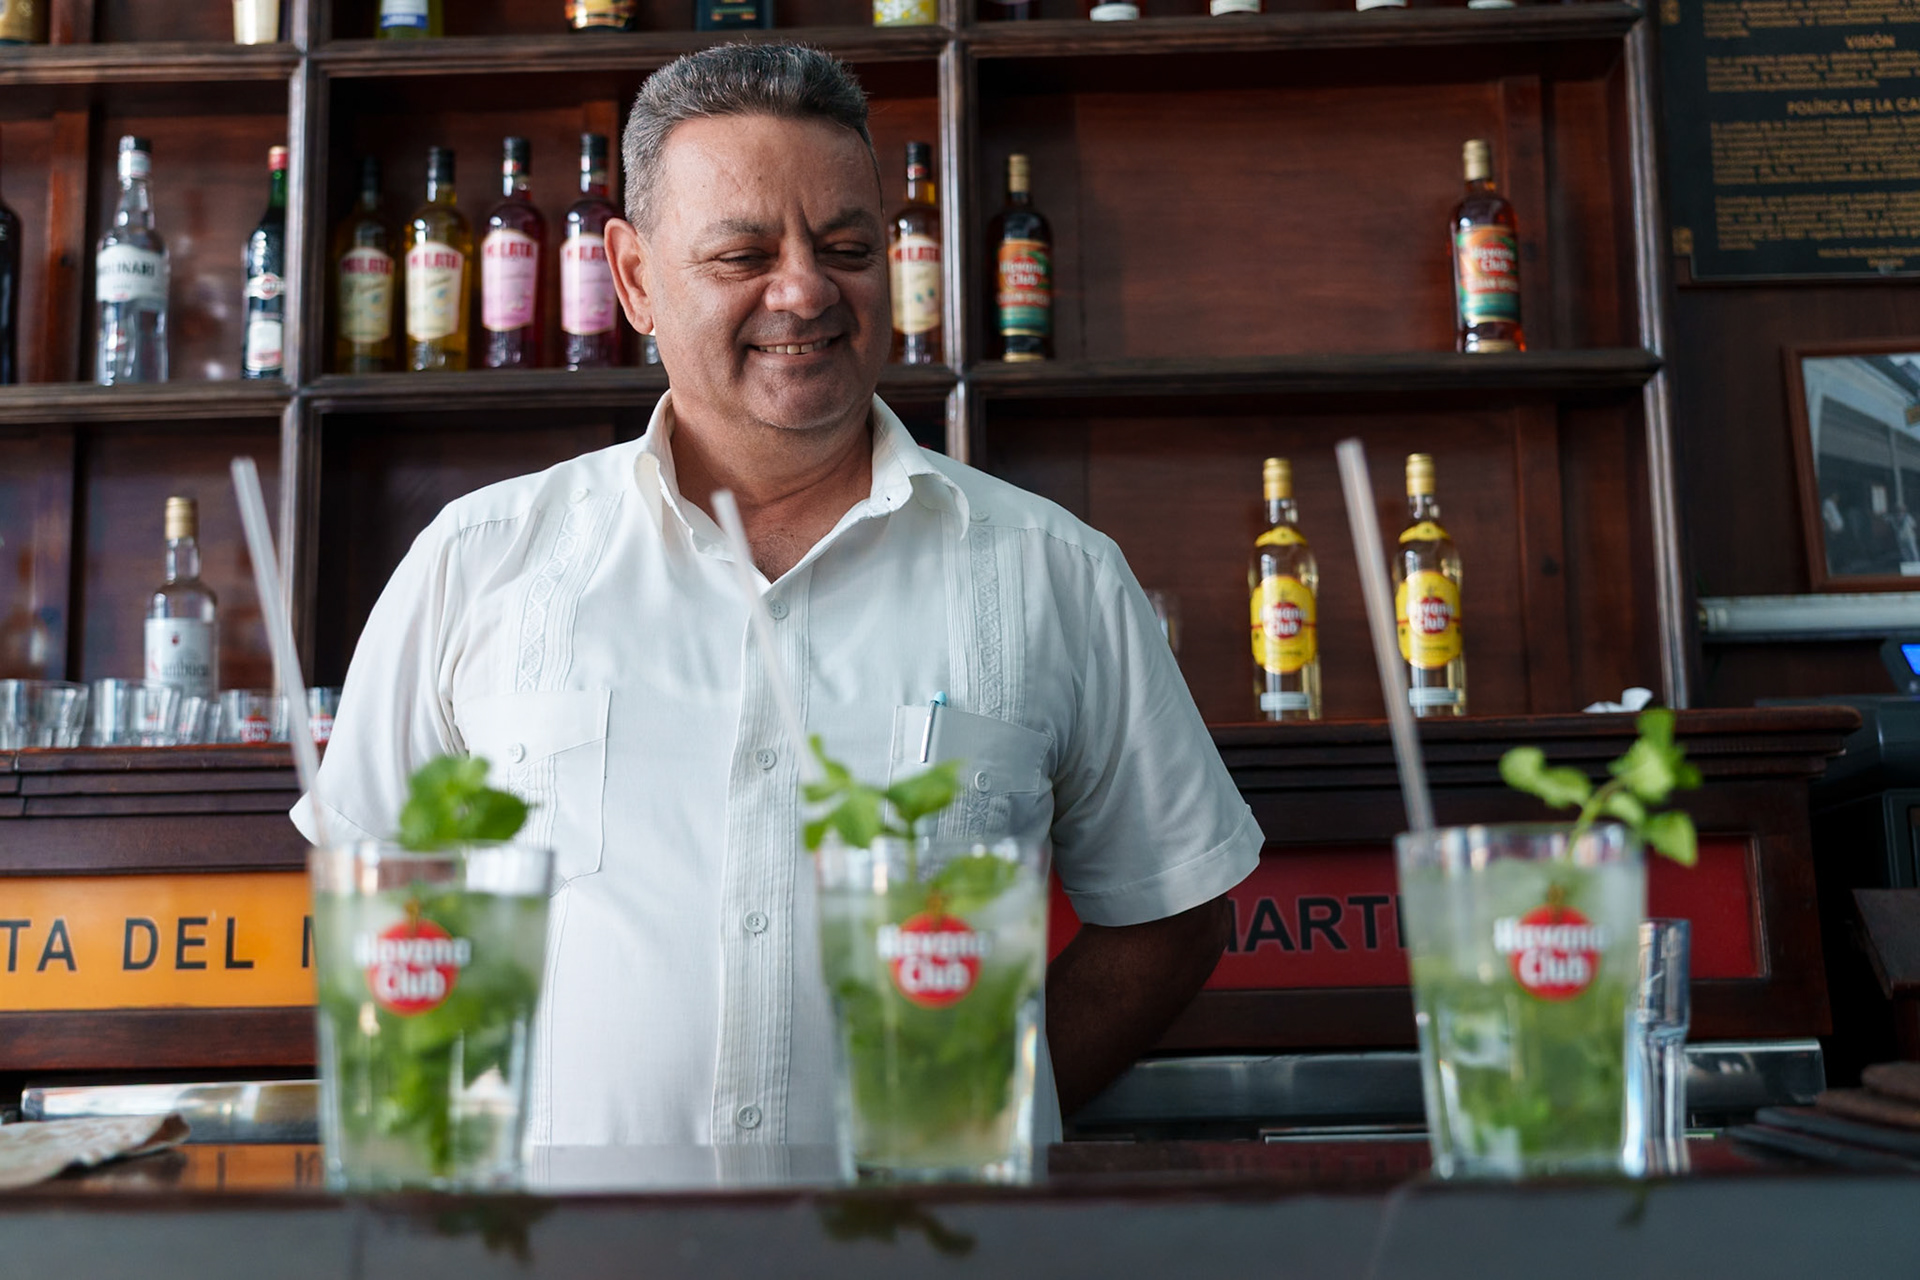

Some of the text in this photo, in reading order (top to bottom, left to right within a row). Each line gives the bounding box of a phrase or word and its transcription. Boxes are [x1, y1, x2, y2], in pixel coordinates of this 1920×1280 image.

[408, 252, 459, 270] MLATA
[486, 240, 534, 259] MLATA
[893, 247, 940, 261] MLATA
[1228, 895, 1408, 954] ARTI
[122, 917, 255, 971] DEL
[375, 962, 446, 1001] Club
[900, 956, 970, 994] Club
[1519, 948, 1591, 987] Club
